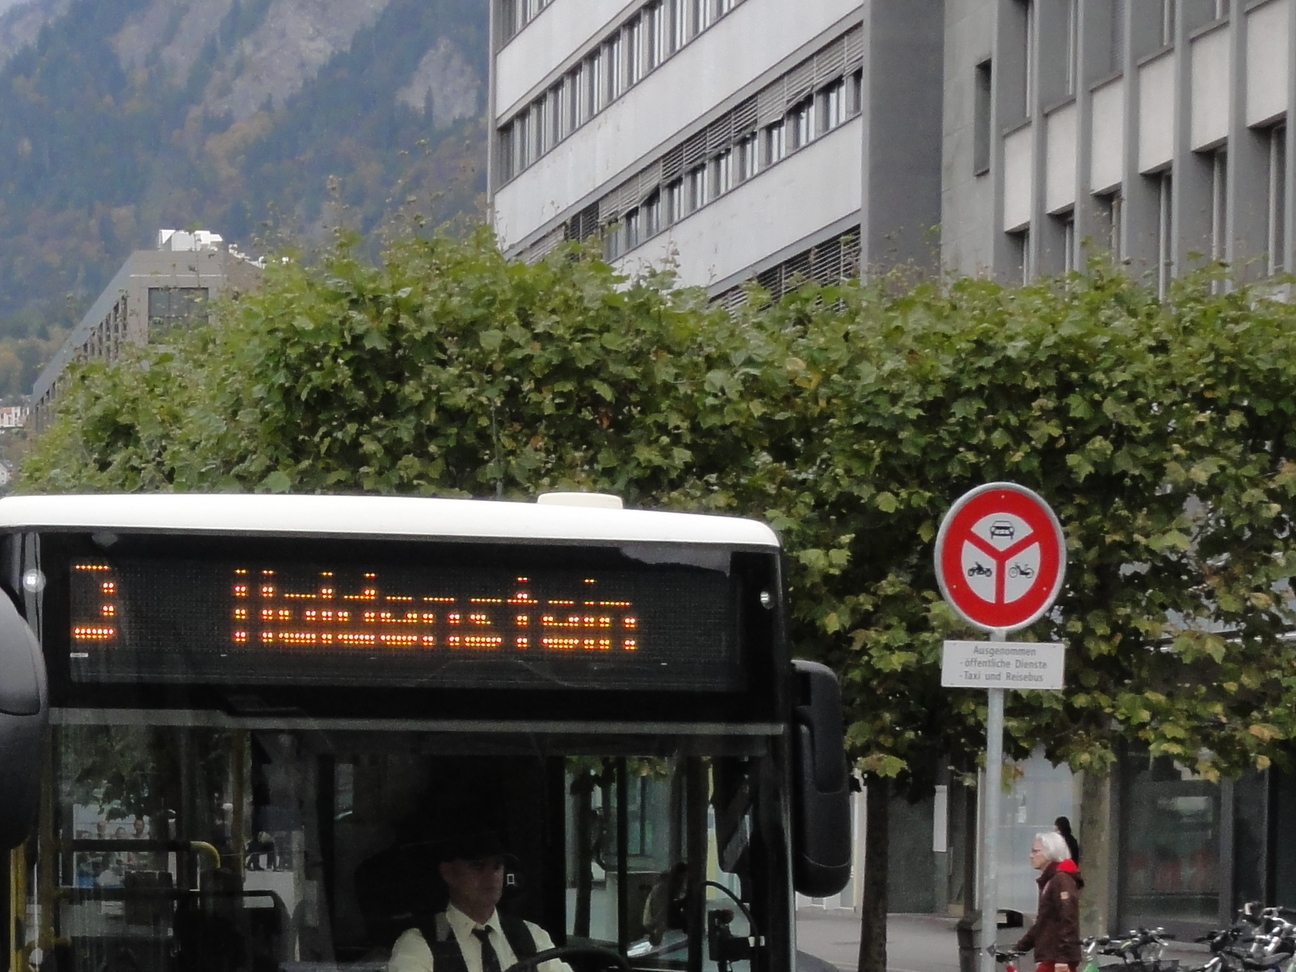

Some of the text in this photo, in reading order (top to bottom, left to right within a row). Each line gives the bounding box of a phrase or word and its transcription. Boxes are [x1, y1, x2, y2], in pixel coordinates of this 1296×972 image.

[973, 646, 1036, 657] Ausgenommen
[1015, 660, 1048, 669] Dienste
[985, 672, 1001, 681] und
[1006, 672, 1044, 682] Reisebus
